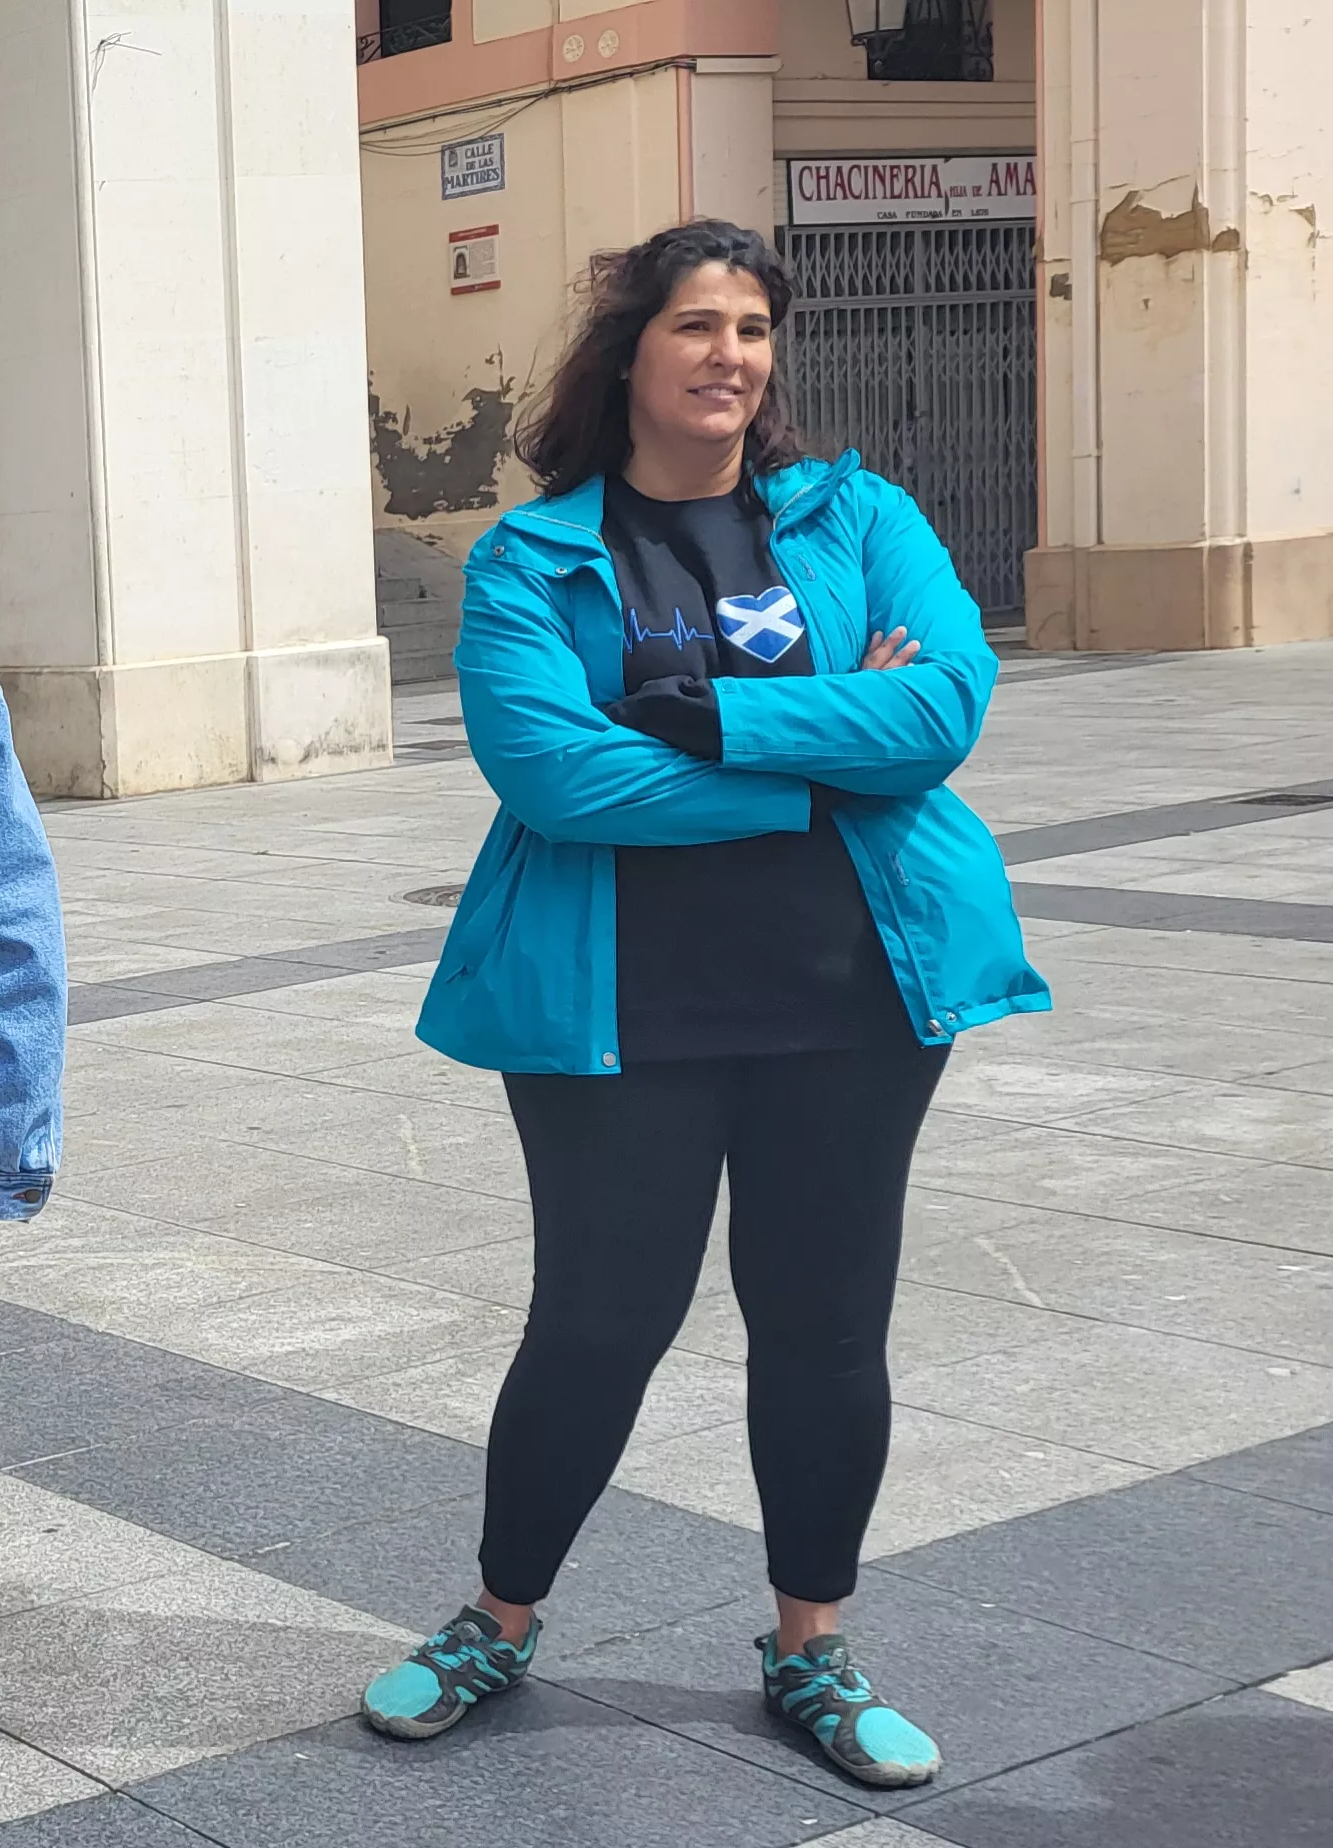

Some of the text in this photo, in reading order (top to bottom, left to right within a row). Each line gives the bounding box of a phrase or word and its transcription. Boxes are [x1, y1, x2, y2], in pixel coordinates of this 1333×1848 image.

[464, 143, 494, 160] CALLE
[465, 161, 476, 172] DE
[798, 163, 944, 202] CHACINERIA
